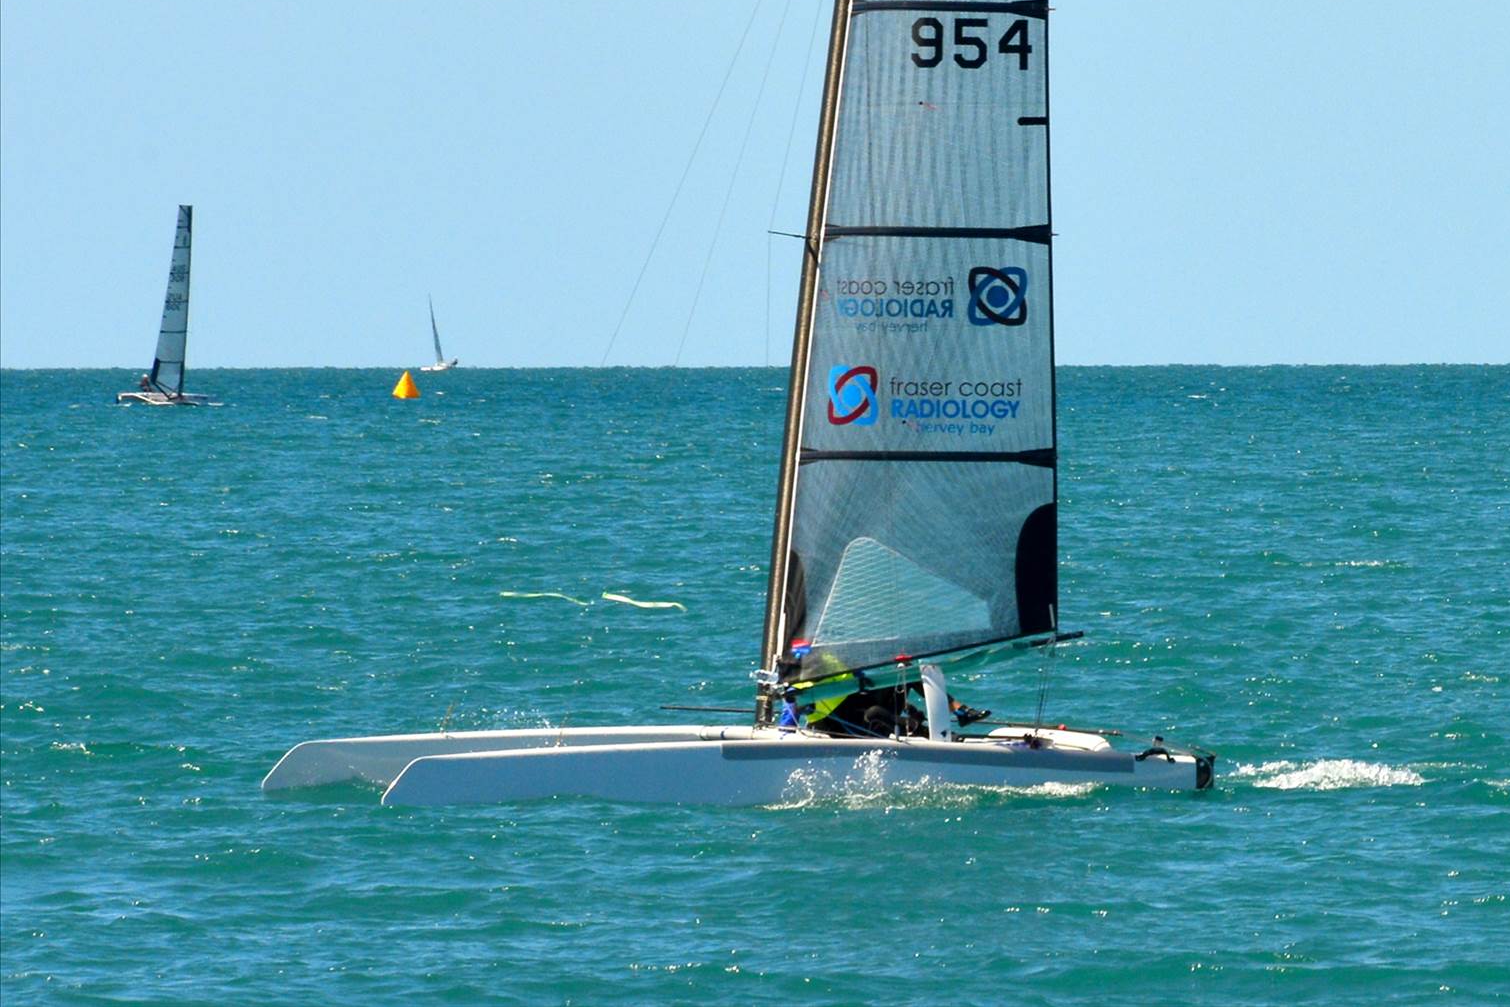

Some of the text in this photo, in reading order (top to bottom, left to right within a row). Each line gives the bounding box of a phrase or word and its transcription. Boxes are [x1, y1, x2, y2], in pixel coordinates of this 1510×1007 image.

[911, 16, 1033, 71] 954
[890, 376, 1022, 397] fraser coast
[890, 398, 1020, 419] RADIOLOGY
[969, 421, 996, 436] bay
